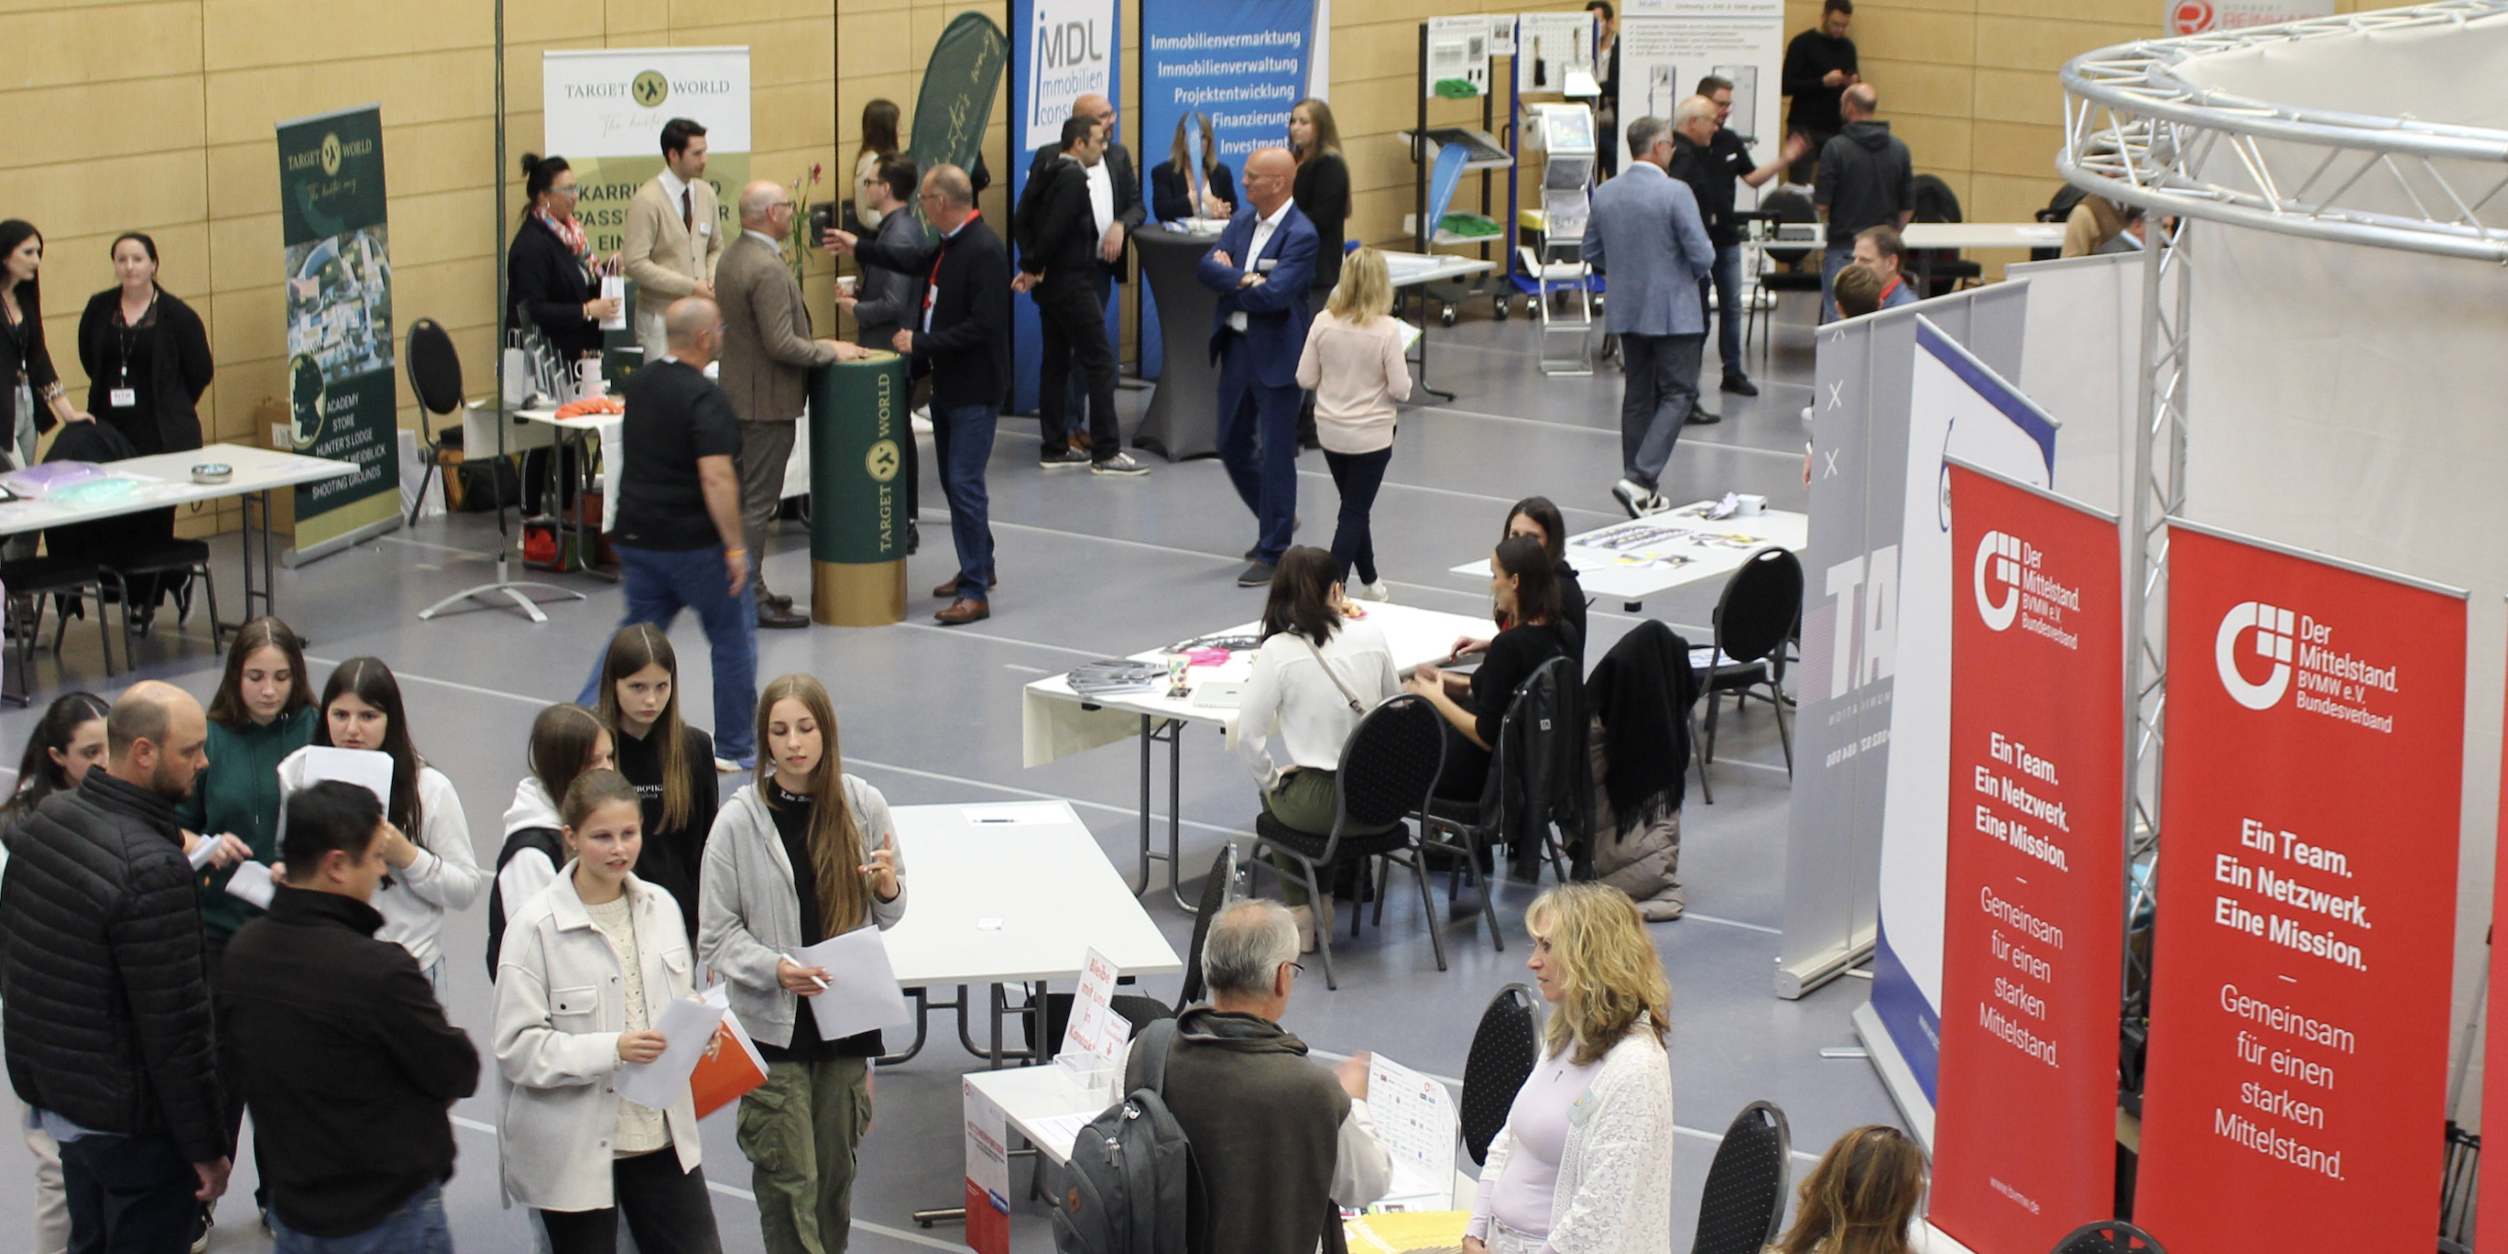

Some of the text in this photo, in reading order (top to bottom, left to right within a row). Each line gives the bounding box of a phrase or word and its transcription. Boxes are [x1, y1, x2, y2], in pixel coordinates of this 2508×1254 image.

[1152, 30, 1301, 49] Immobilienvermarktung
[565, 80, 730, 98] TARGET WORLD
[1158, 57, 1298, 77] Immobilienverwaltung
[1174, 83, 1295, 106] Projektentwicklung
[1212, 111, 1291, 129] Finanzierung
[287, 139, 373, 171] TARGET WORLD
[326, 391, 360, 415] ACADEMY
[332, 413, 355, 433] STORE
[351, 427, 373, 446] LODGE
[312, 464, 382, 500] SHOOTING GROUNDS
[877, 373, 893, 552] TARGET WORLD
[2023, 541, 2043, 569] Der
[2022, 566, 2081, 612] Mittelstand.
[2021, 611, 2078, 650] Bundesverband
[2301, 615, 2332, 645] Der
[2298, 670, 2366, 704] BVMW e.V.
[2299, 642, 2399, 693] Mittelstand.
[2296, 690, 2393, 734] Bundesverband
[1990, 731, 2059, 786] Ein Team.
[1975, 765, 2070, 833] Ein Netzwerk.
[1976, 804, 2069, 873] Eine Mission.
[2241, 817, 2353, 879] Ein Team.
[2215, 853, 2372, 930] Ein Netzwerk.
[1980, 886, 2064, 950] Gemeinsam
[2215, 896, 2368, 972] Eine Mission.
[1089, 957, 1111, 984] Bleibe
[1992, 929, 2052, 983] für einen
[1083, 1006, 1092, 1024] in
[1093, 992, 1107, 1008] uns
[1994, 976, 2046, 1021] starken
[2220, 983, 2355, 1055] Gemeinsam
[1979, 1001, 2060, 1069] Mittelstand.
[2237, 1030, 2334, 1090] für einen
[2240, 1081, 2324, 1130] starken
[2214, 1107, 2346, 1182] Mittelstand.
